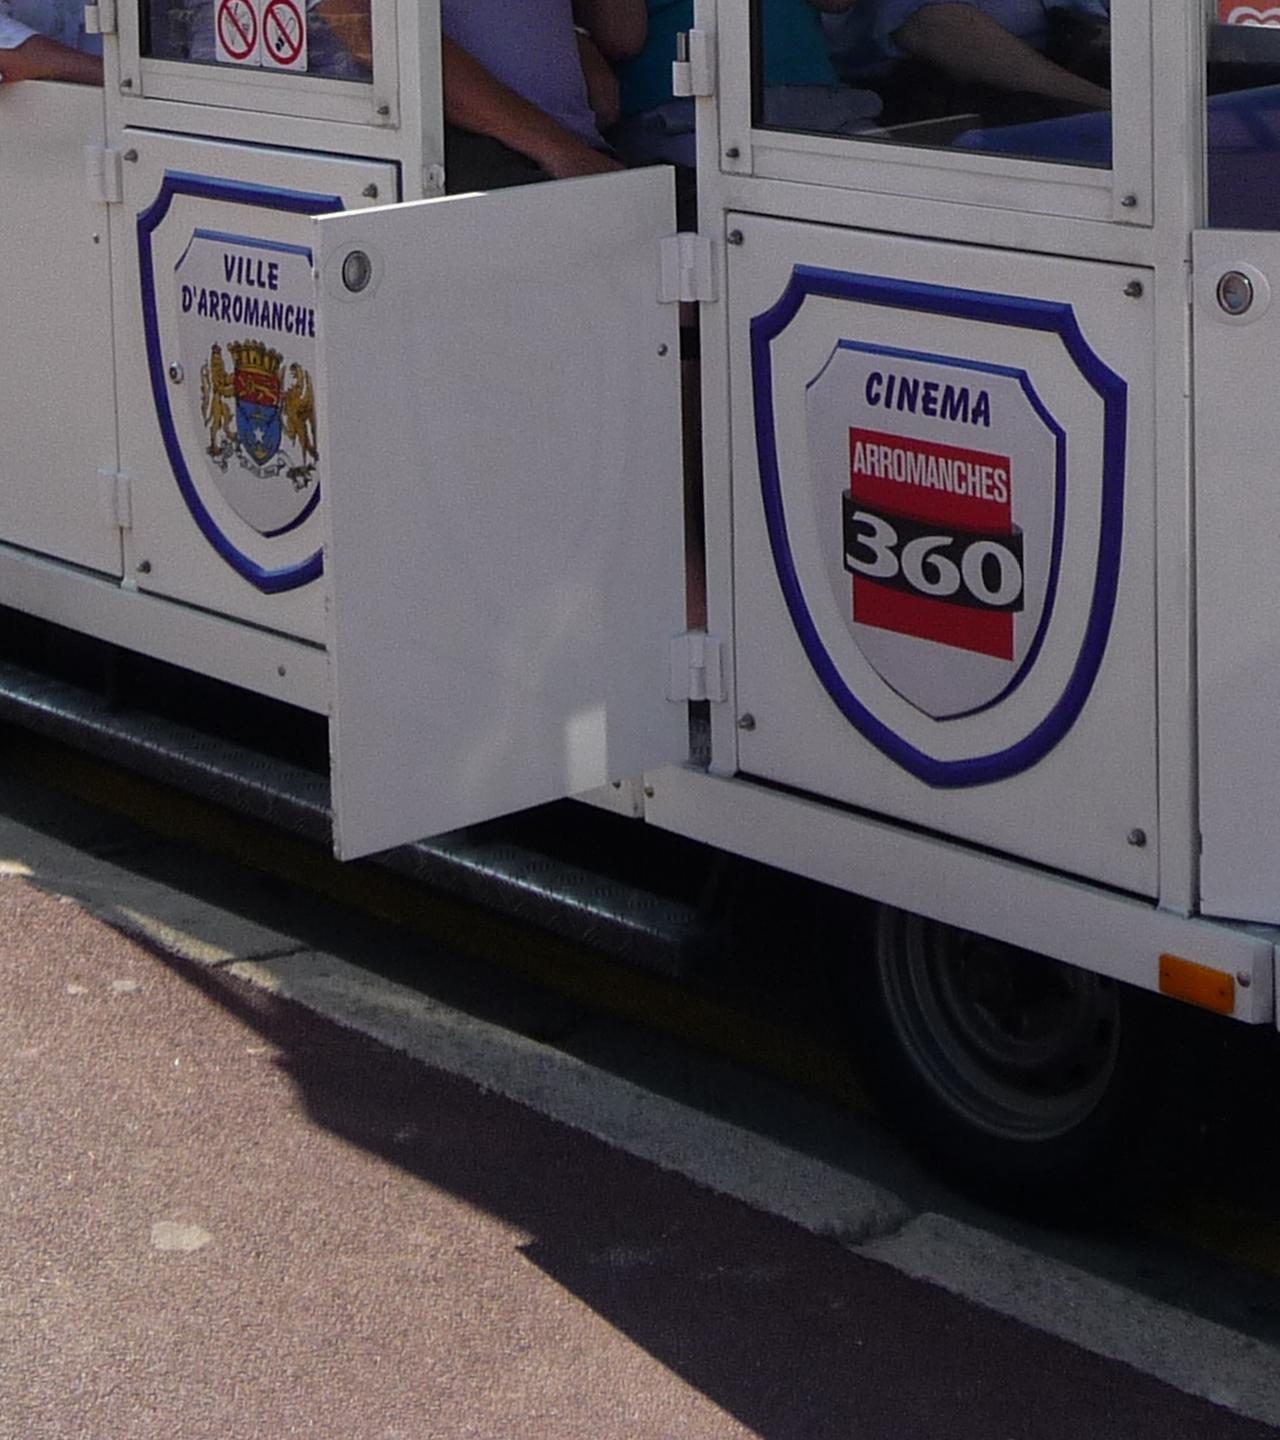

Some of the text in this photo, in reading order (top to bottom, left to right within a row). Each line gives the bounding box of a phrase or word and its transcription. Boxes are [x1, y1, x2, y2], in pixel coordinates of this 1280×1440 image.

[223, 253, 280, 291] VILLE
[865, 371, 992, 428] CINEMA
[853, 440, 1008, 504] ARROMANCHES
[845, 510, 1024, 607] 360
